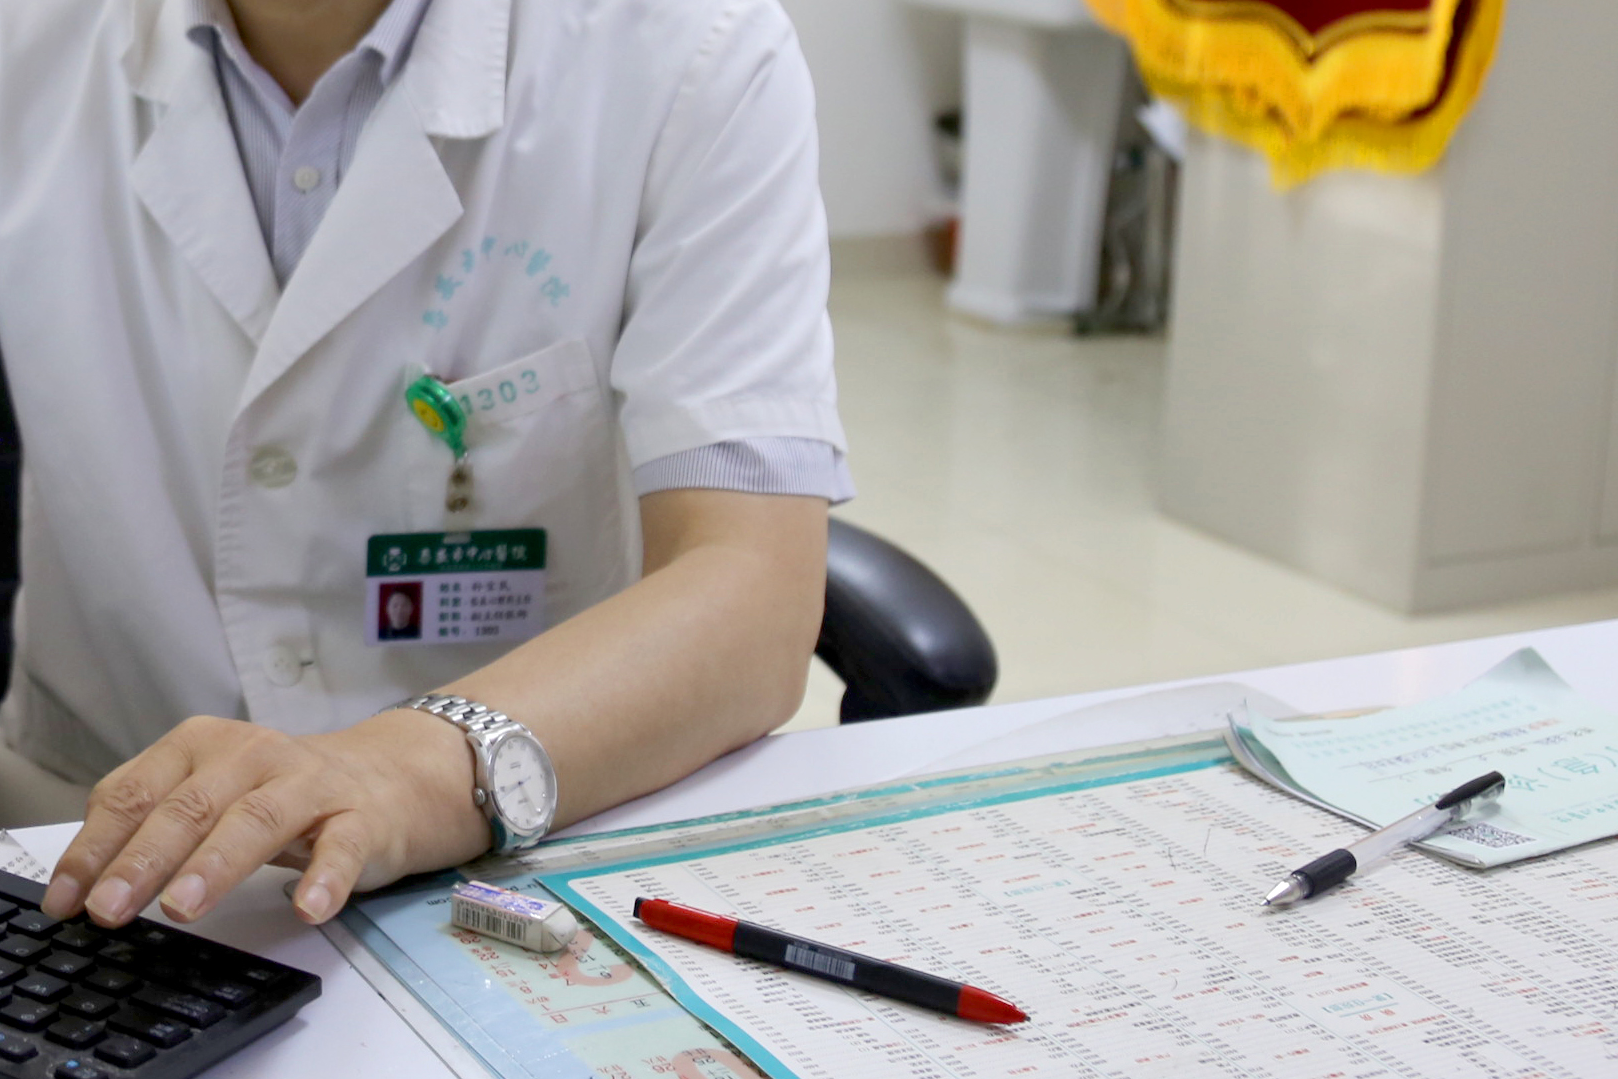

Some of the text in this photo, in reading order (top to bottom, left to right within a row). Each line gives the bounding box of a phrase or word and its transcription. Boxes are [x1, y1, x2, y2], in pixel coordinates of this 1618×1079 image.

[460, 369, 541, 416] 1303
[599, 971, 612, 979] 6
[549, 1014, 568, 1024] 日
[691, 1054, 716, 1066] 25
[651, 1062, 676, 1074] 26
